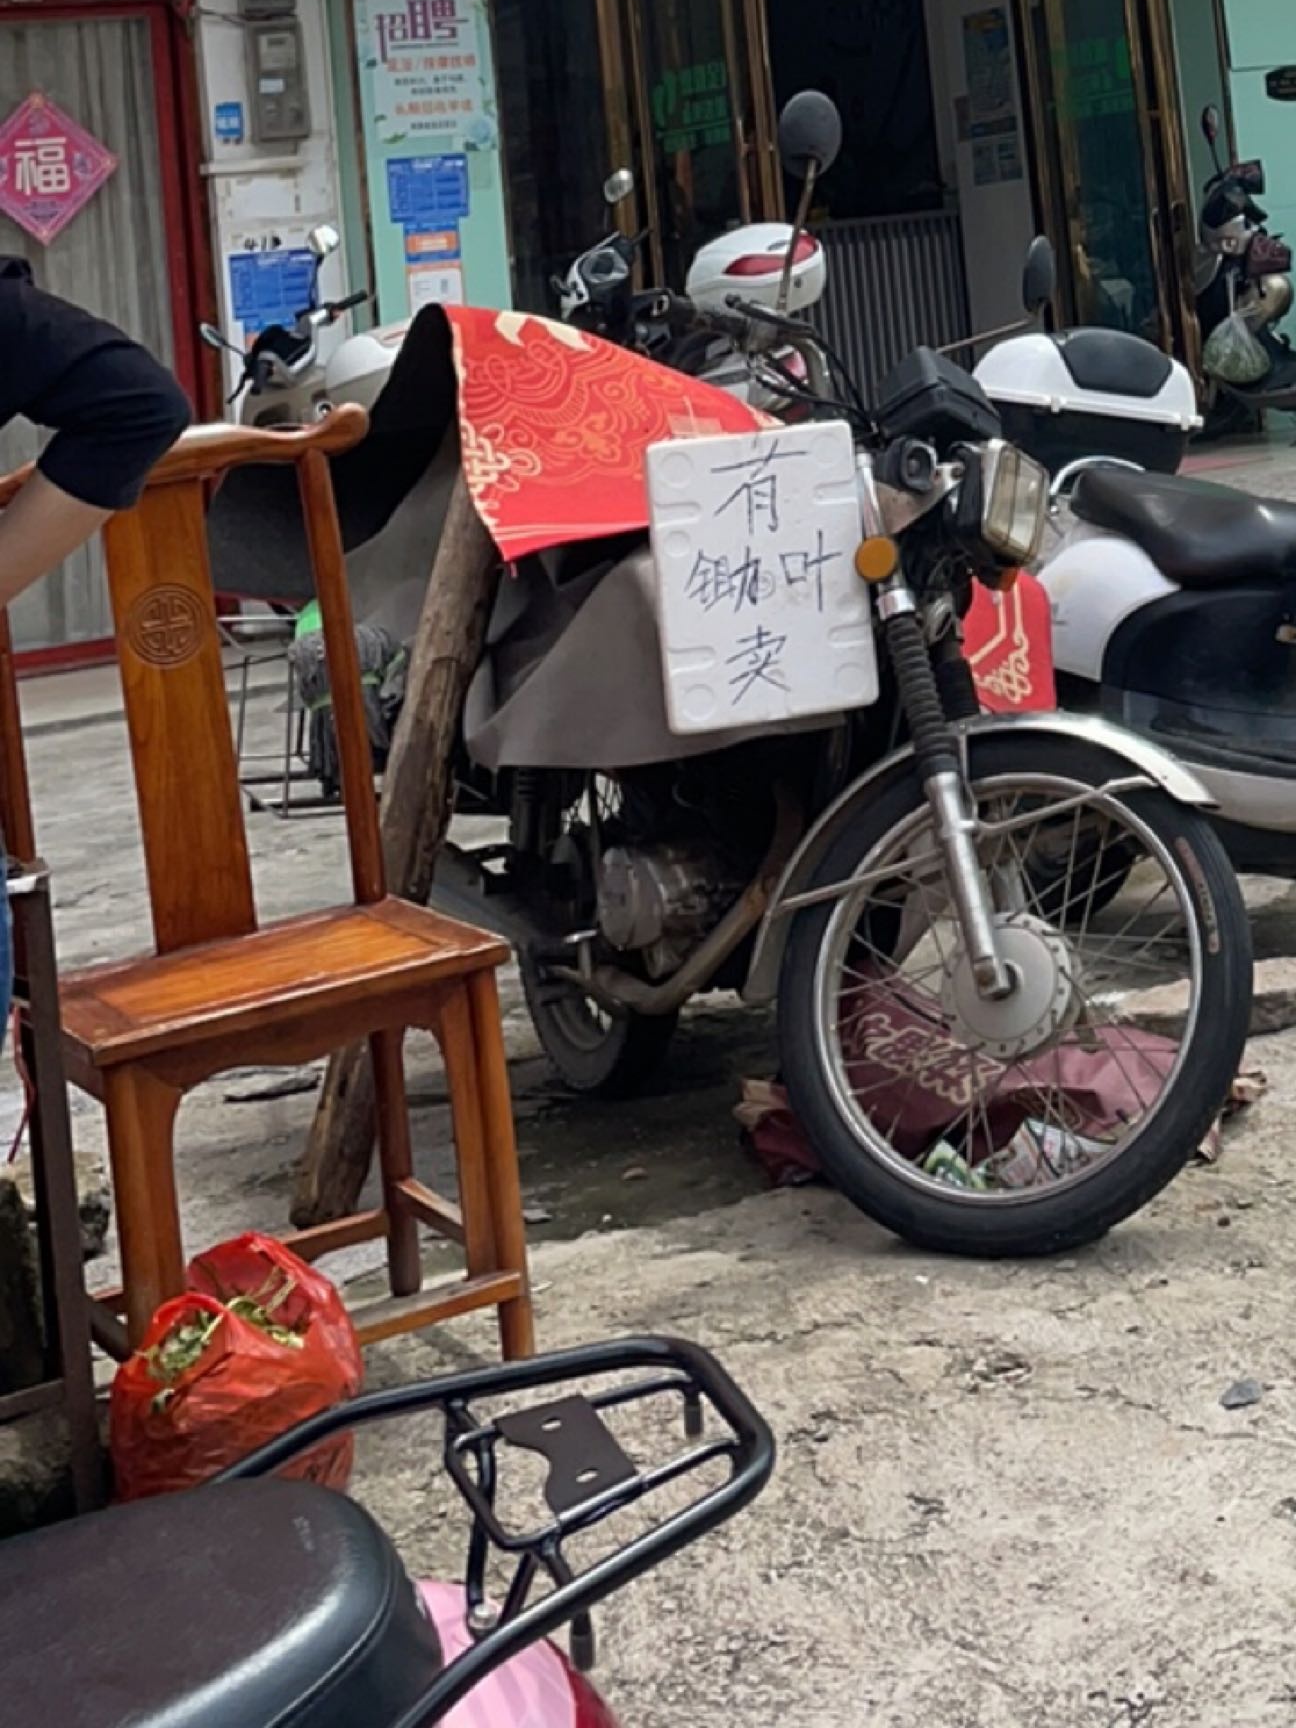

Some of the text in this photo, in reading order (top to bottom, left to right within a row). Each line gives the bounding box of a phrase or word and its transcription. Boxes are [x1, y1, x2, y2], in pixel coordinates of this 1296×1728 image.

[14, 136, 71, 196] 福
[711, 439, 807, 535] 有
[726, 624, 791, 706] 卖
